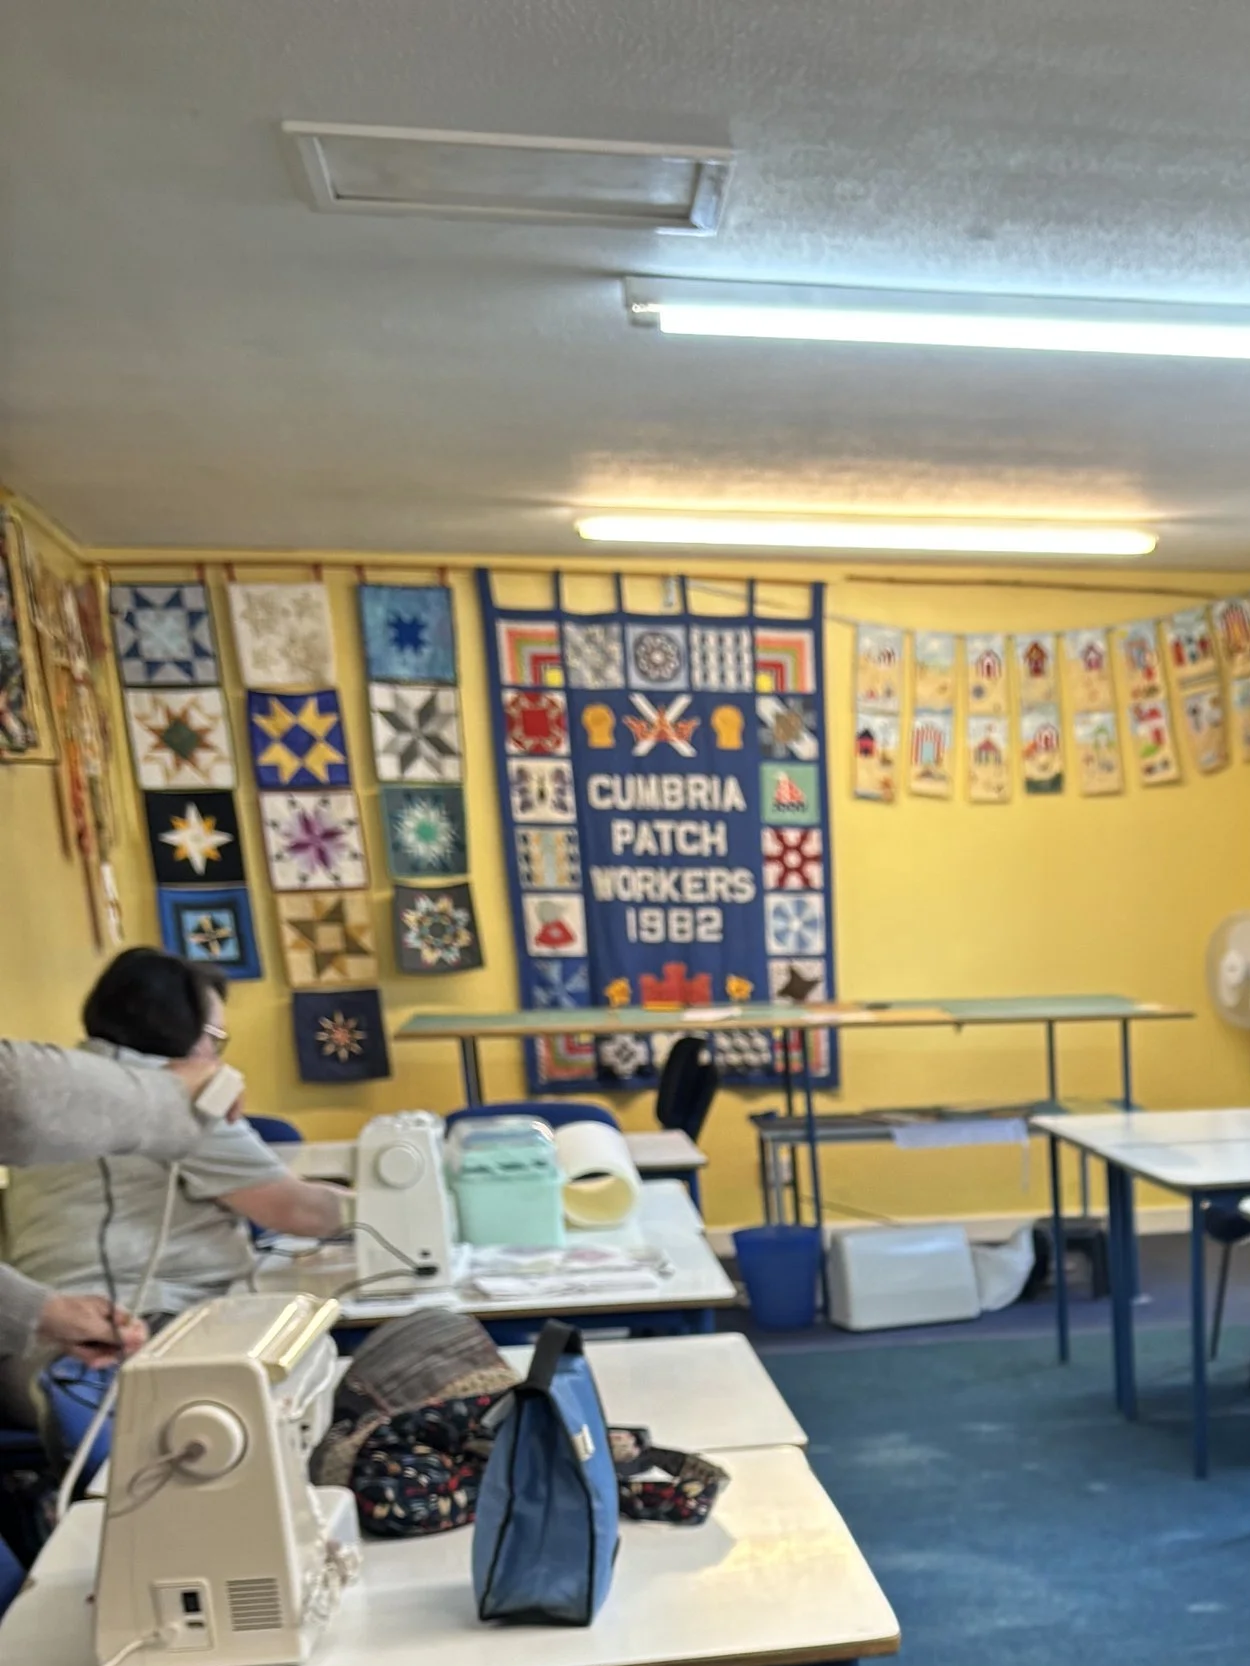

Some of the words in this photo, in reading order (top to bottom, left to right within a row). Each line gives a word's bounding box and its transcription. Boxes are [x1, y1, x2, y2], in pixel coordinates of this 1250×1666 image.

[587, 773, 748, 812] CUMBRIA
[611, 818, 728, 857] PATCH
[590, 865, 756, 903] WORKERS
[626, 905, 724, 943] 1982
